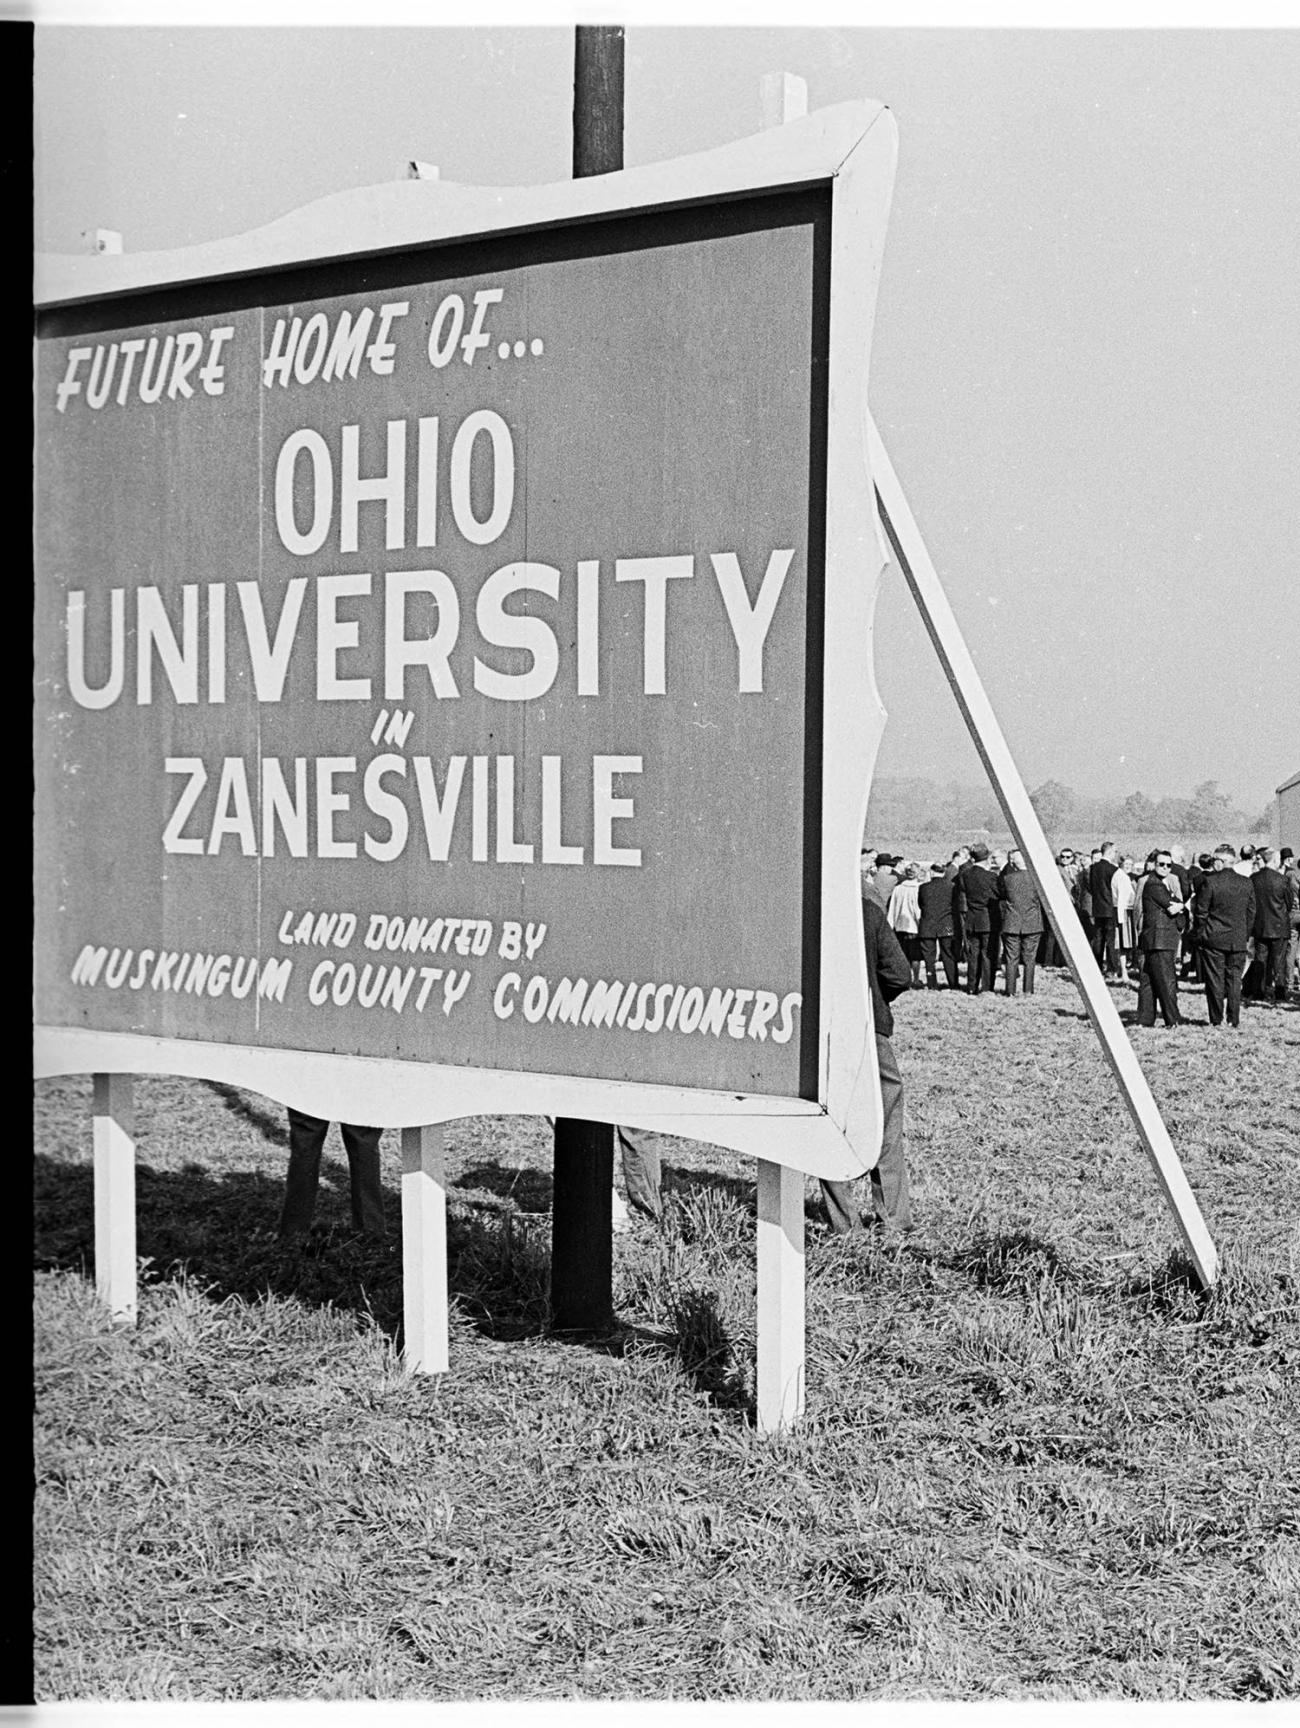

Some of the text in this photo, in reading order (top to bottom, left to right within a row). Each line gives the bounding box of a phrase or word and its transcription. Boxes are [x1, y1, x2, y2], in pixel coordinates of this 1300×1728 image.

[56, 326, 235, 413] FUTURE
[262, 301, 410, 388] HOME
[274, 409, 515, 555] OHIO
[66, 548, 796, 709] UNIVERSITY
[370, 709, 414, 746] IN
[162, 754, 644, 867] ZANESVILLE
[279, 910, 547, 961] LAND DONATED BY
[71, 945, 803, 1044] MUSKINGUM COUNTY COMMISSIONERS
